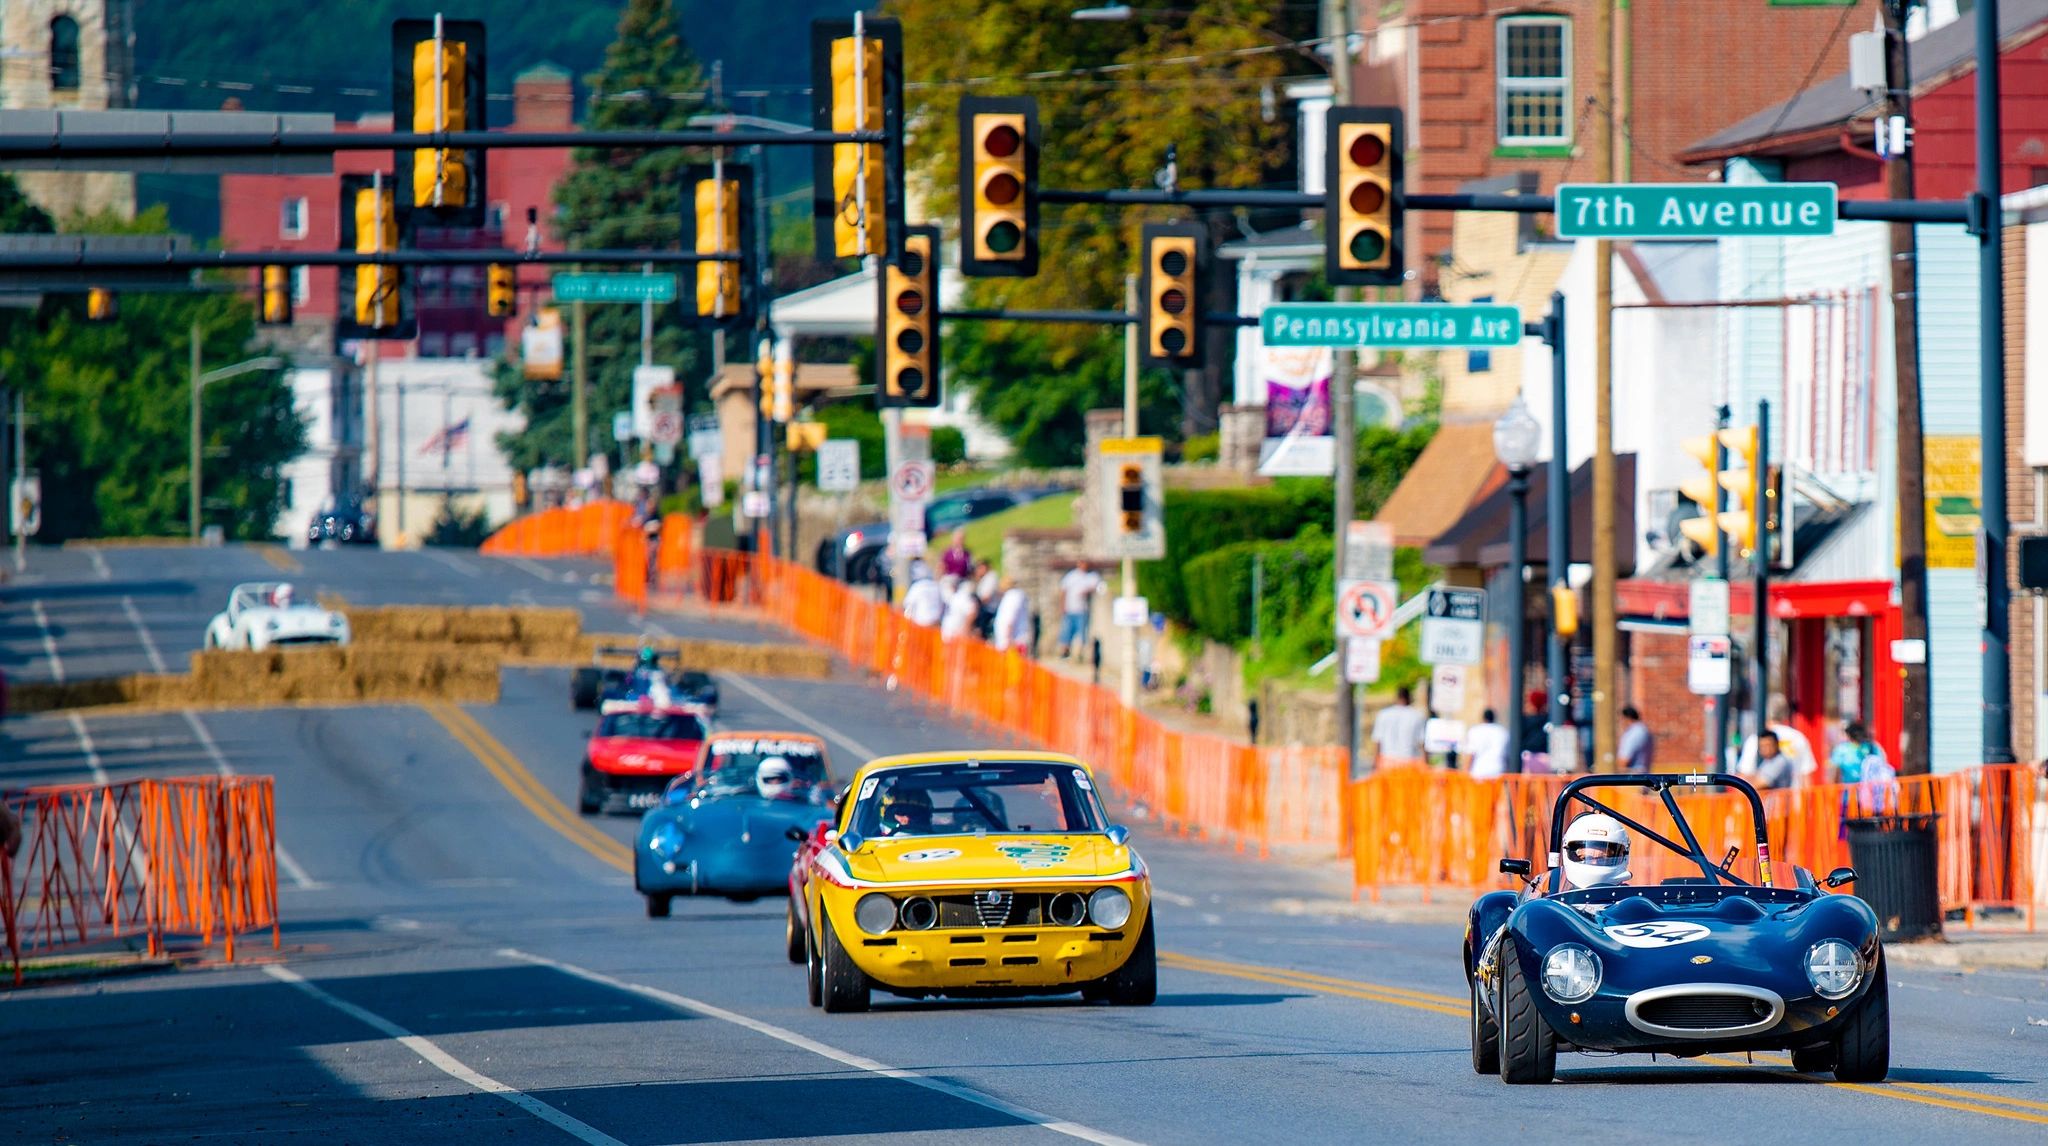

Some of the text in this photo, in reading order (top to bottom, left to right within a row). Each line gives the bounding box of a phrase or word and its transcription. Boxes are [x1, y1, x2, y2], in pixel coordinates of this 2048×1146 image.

[1573, 195, 1822, 227] 7th Avenue
[1272, 311, 1512, 346] Pennsylvania Ave
[1613, 923, 1705, 943] 54
